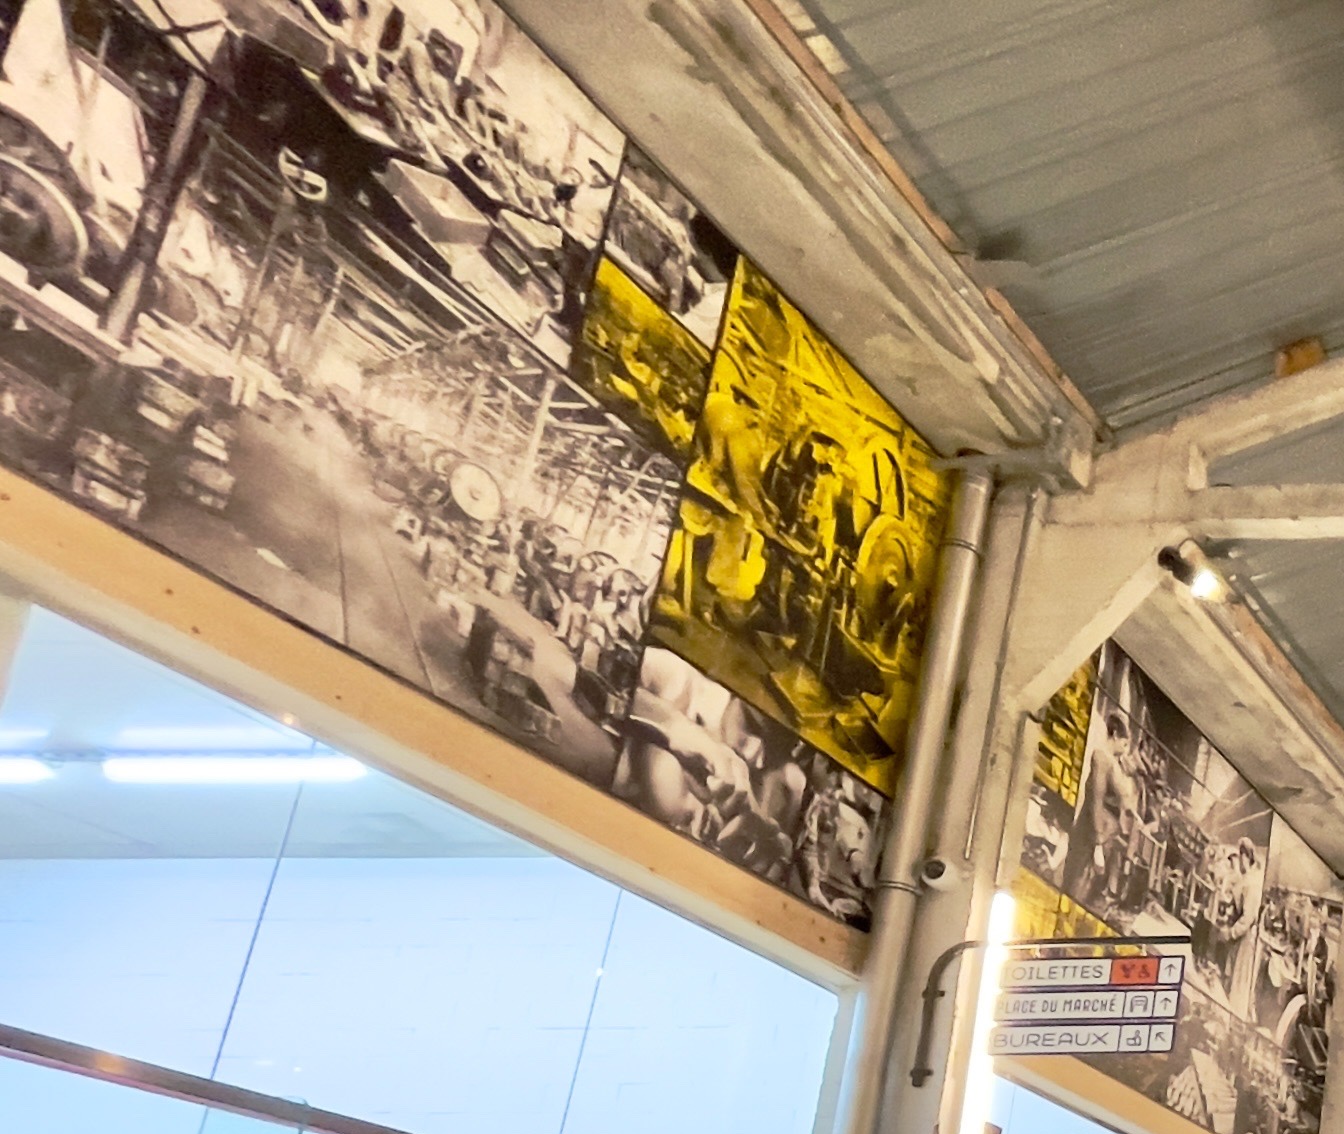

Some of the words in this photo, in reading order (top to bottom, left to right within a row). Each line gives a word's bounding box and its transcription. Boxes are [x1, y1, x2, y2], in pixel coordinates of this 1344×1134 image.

[1041, 998, 1058, 1013] DU
[1063, 994, 1117, 1012] MARCHÉ
[993, 1032, 1109, 1048] BUREAUX
